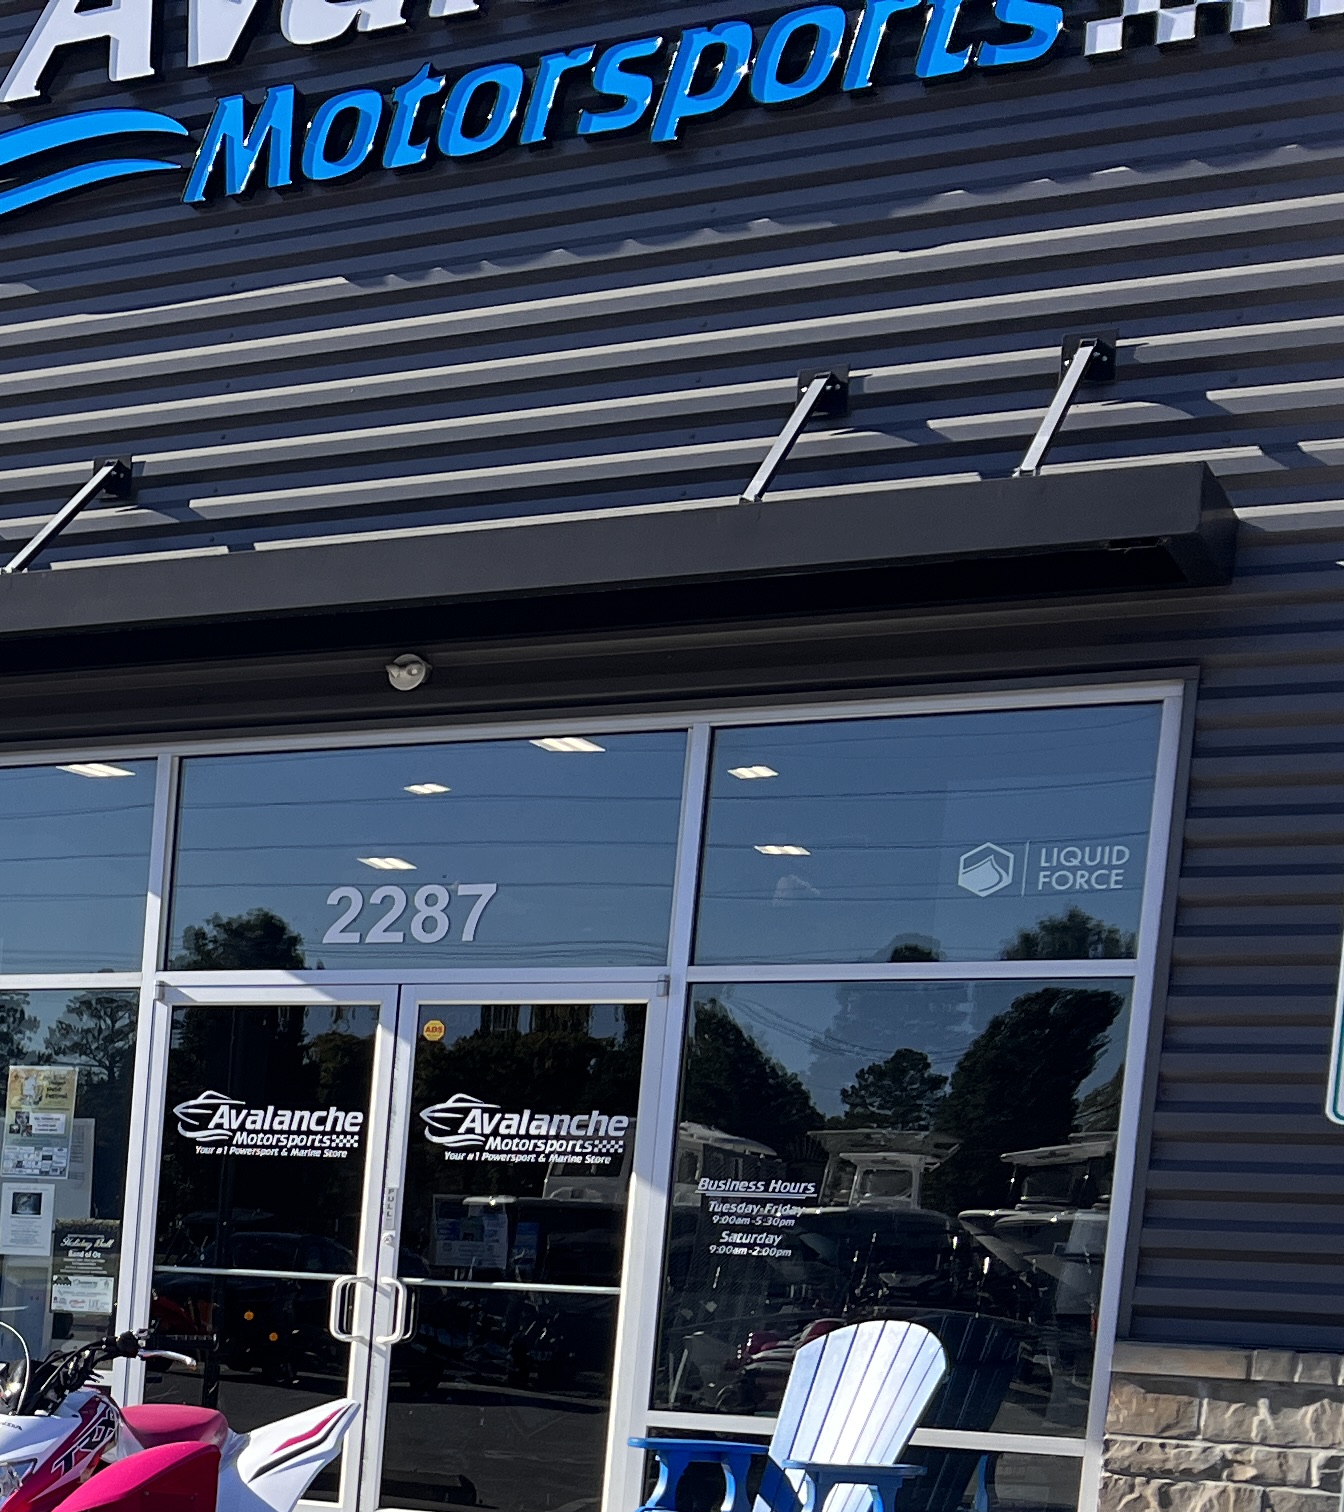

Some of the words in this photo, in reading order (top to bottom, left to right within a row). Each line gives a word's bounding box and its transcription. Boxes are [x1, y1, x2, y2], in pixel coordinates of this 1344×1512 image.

[182, 0, 1065, 203] Motorsports
[1039, 845, 1130, 867] LIQUID
[1038, 869, 1125, 891] FORCE
[322, 883, 498, 944] 2287
[208, 1104, 364, 1132] Avalanche
[457, 1108, 629, 1137] Avalanche
[233, 1131, 332, 1149] Motorsports
[485, 1136, 594, 1153] Motorsports
[195, 1145, 215, 1155] Your
[229, 1146, 279, 1157] Powersport
[290, 1148, 321, 1157] Marine
[323, 1149, 348, 1158] Store
[444, 1151, 464, 1161] Your
[481, 1152, 536, 1163] Powersport
[548, 1153, 583, 1163] Marine
[584, 1155, 612, 1164] Store
[698, 1177, 766, 1192] Business
[769, 1180, 816, 1194] Hours
[386, 1189, 395, 1217] PULL
[719, 1231, 783, 1246] Saturday
